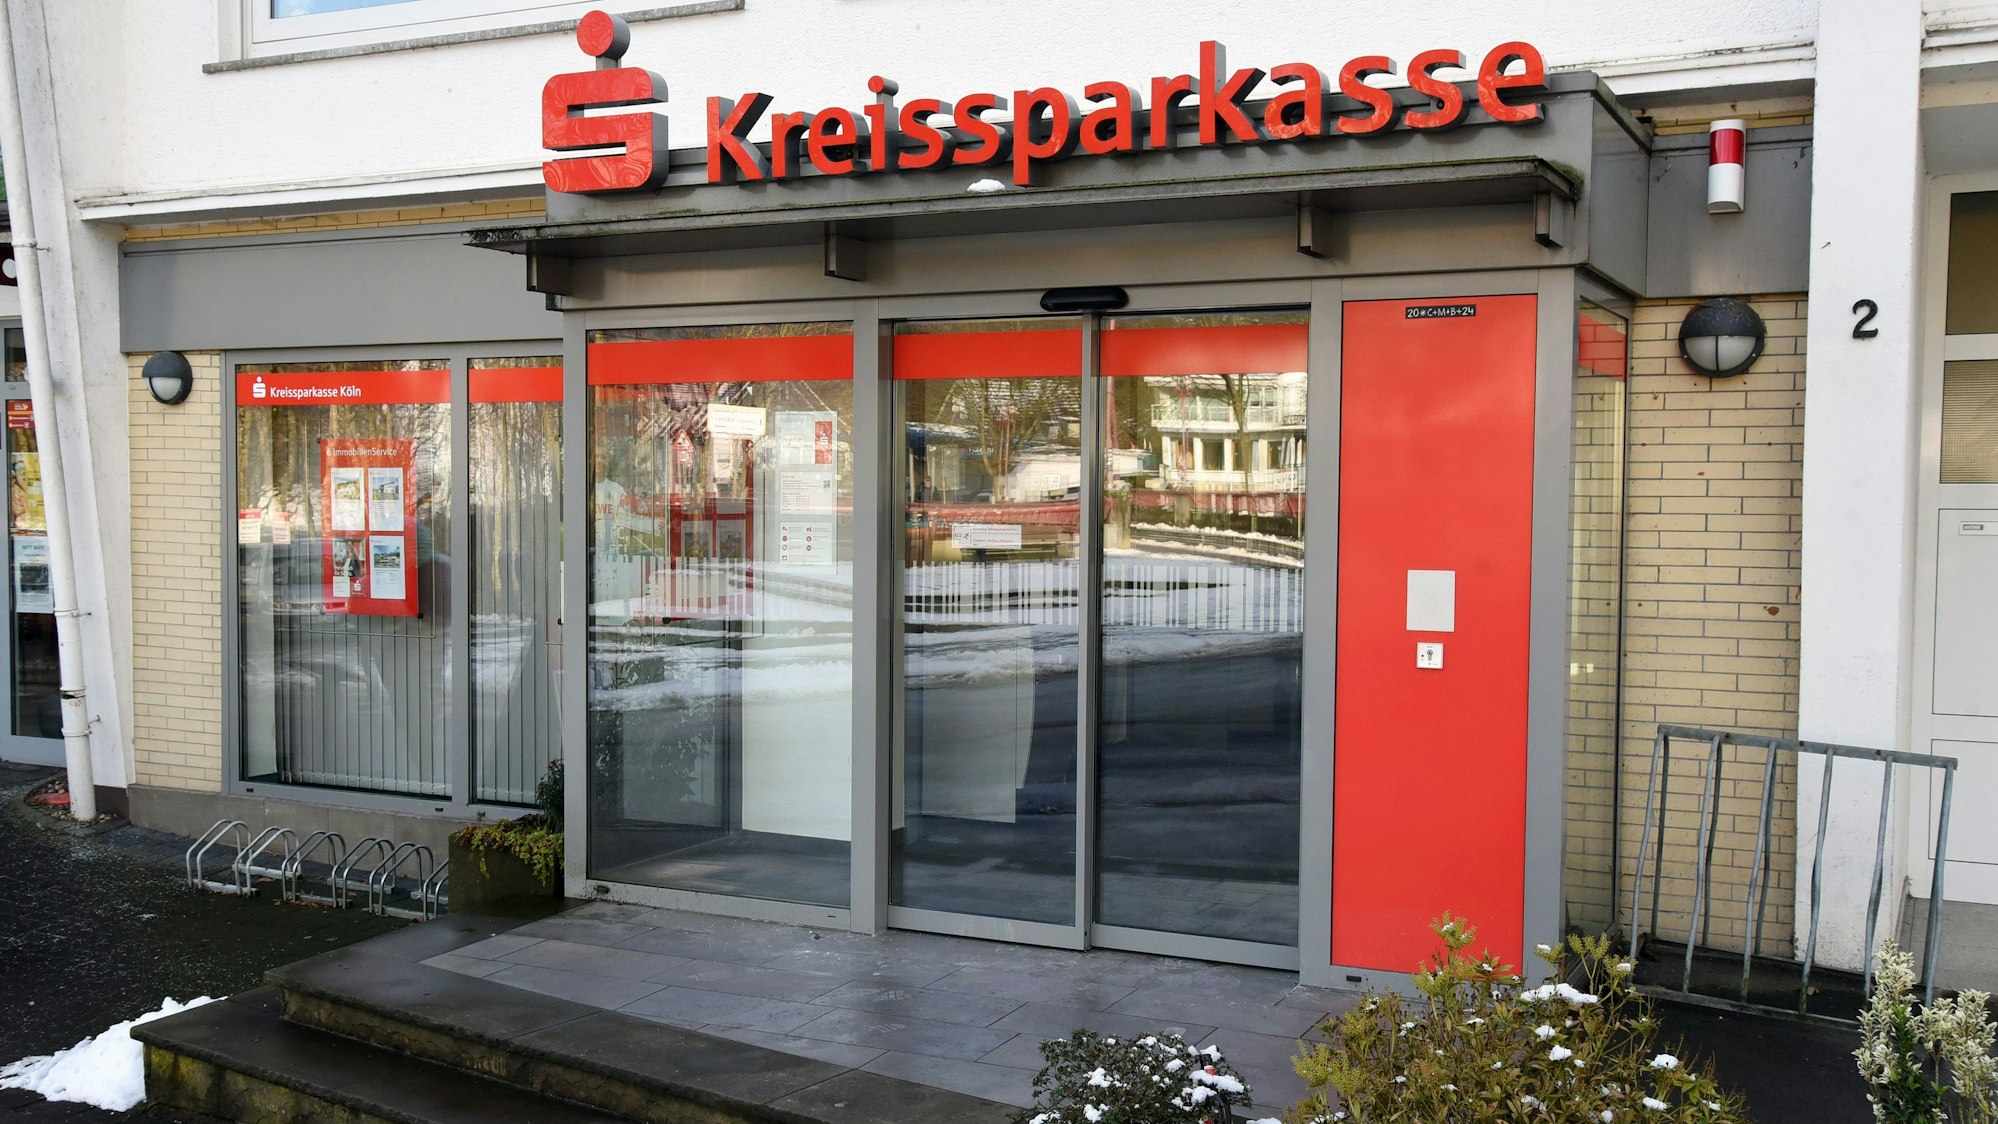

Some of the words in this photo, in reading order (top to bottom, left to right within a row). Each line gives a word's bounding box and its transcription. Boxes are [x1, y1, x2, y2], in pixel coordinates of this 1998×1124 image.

[706, 38, 1549, 187] Kreissparkasse
[1851, 298, 1880, 339] 2
[270, 386, 338, 400] Kreissparkasse
[340, 385, 362, 398] Köln
[333, 447, 398, 456] ImmobilienService
